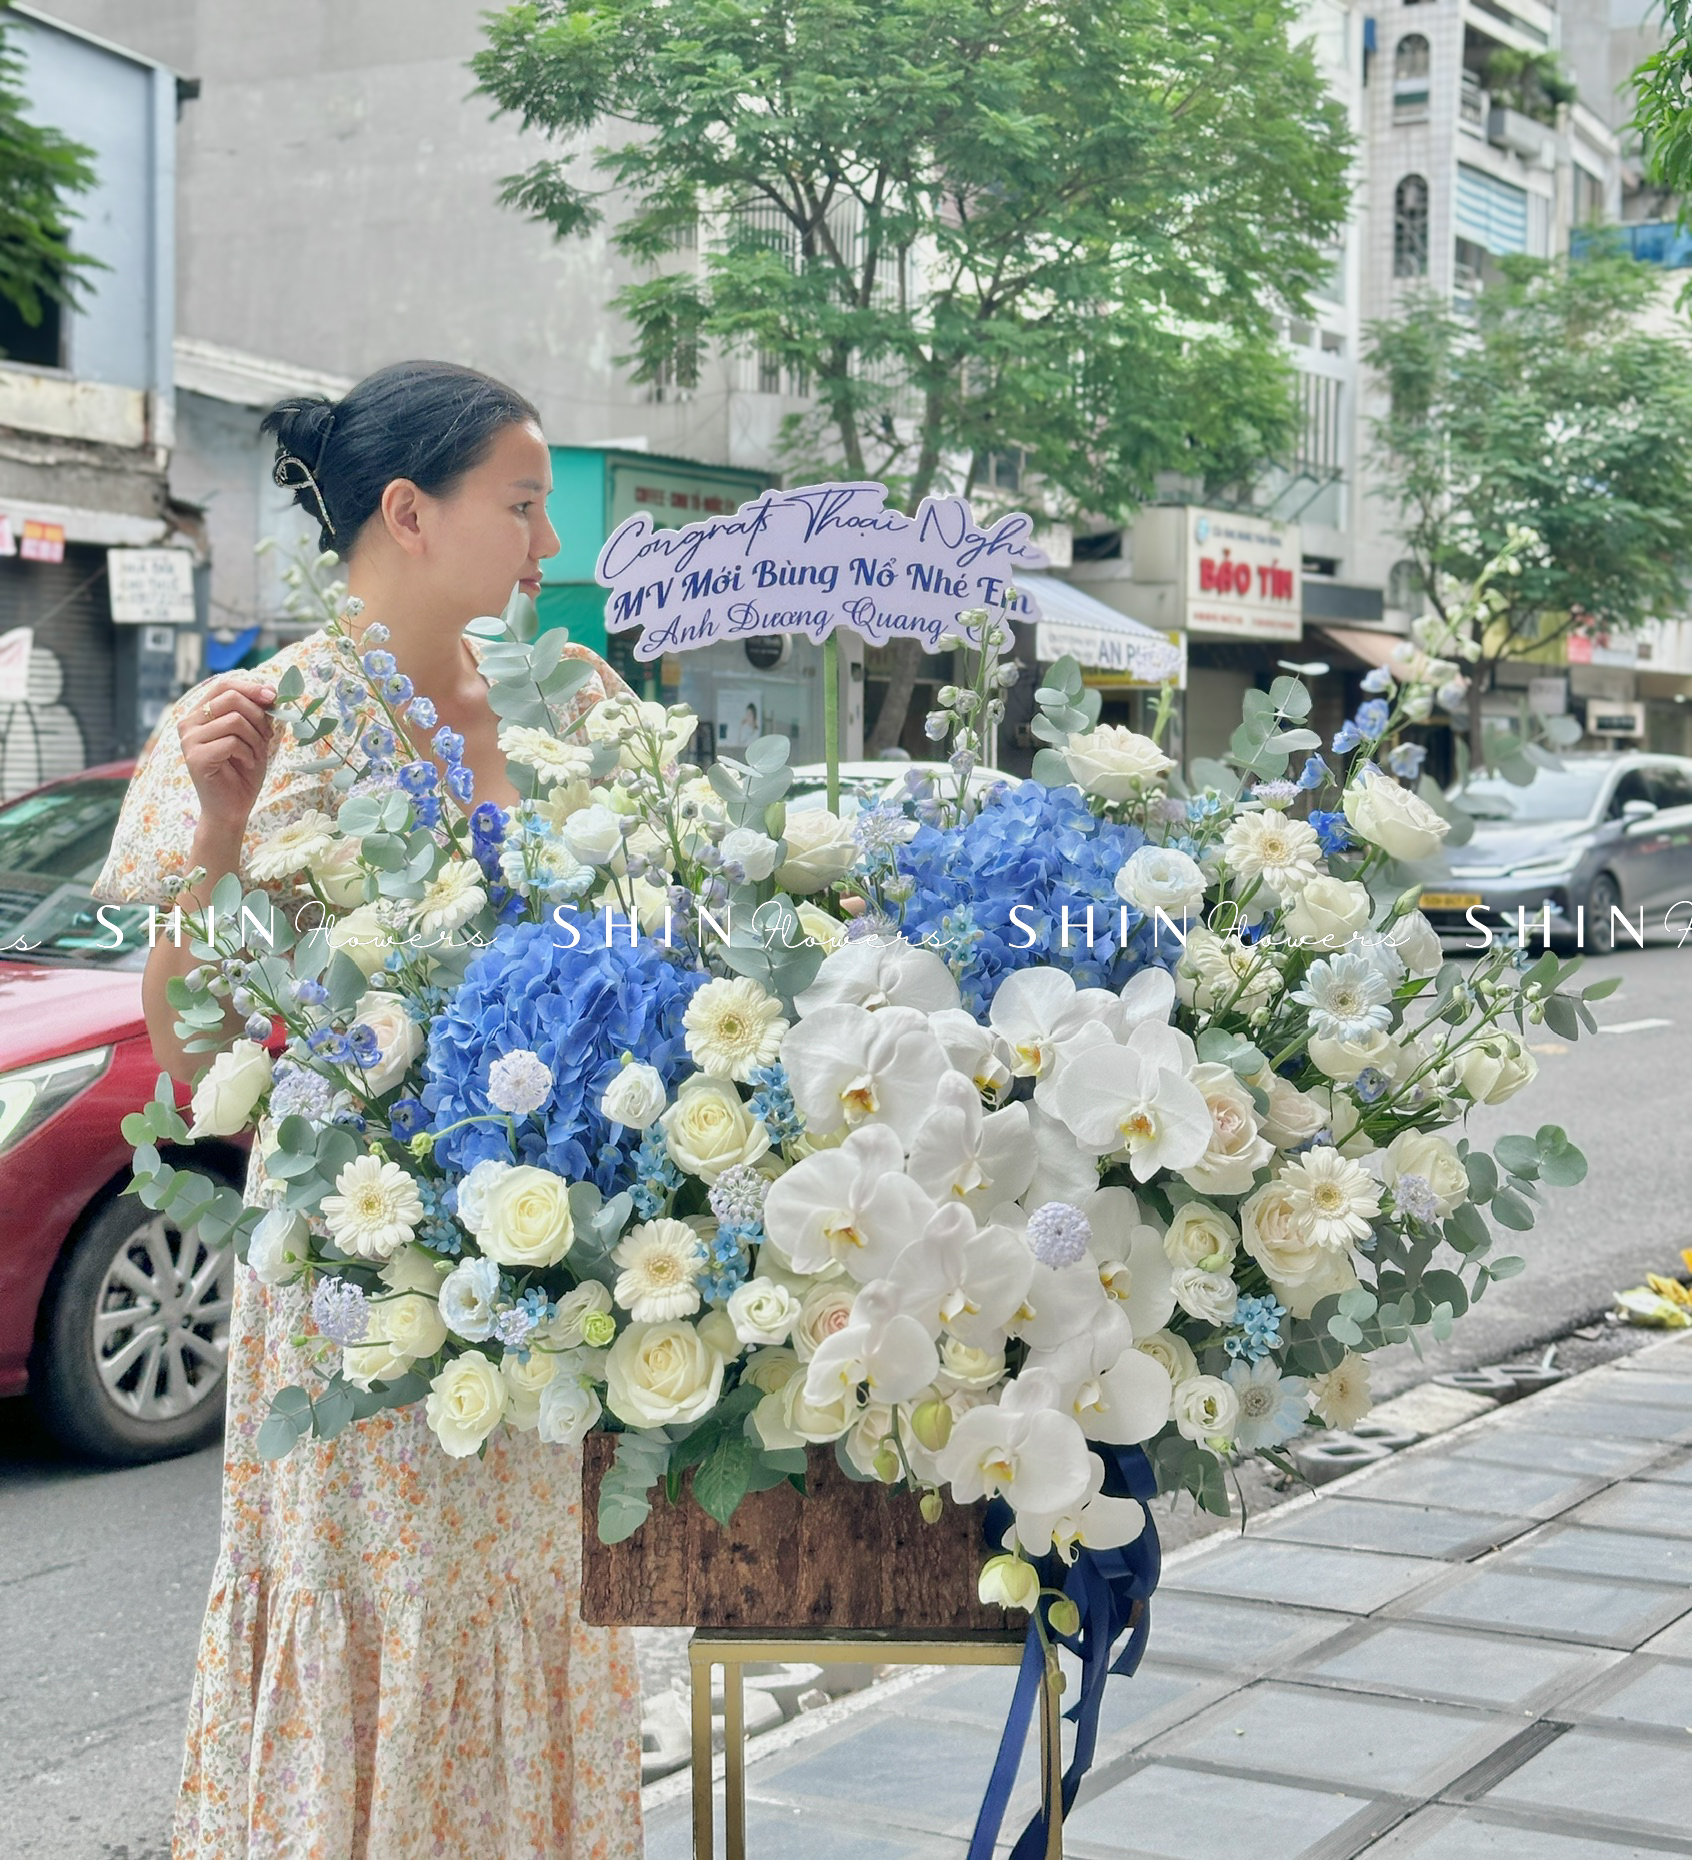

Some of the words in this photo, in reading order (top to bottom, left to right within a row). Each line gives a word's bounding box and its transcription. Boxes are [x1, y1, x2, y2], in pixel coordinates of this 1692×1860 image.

[603, 498, 795, 579] Congrats
[783, 488, 909, 543] Thoại
[920, 501, 1040, 567] Nghi
[614, 577, 674, 624] MV
[682, 565, 745, 601] Mới
[752, 559, 839, 593] Bùng
[850, 557, 899, 587] Nổ
[906, 563, 970, 598] Nhé
[976, 576, 1034, 615] Em
[1199, 548, 1252, 597] BẢO
[642, 608, 720, 653] Anh
[727, 599, 835, 637] Dương
[842, 596, 949, 645] Quang
[1098, 639, 1122, 666] AN
